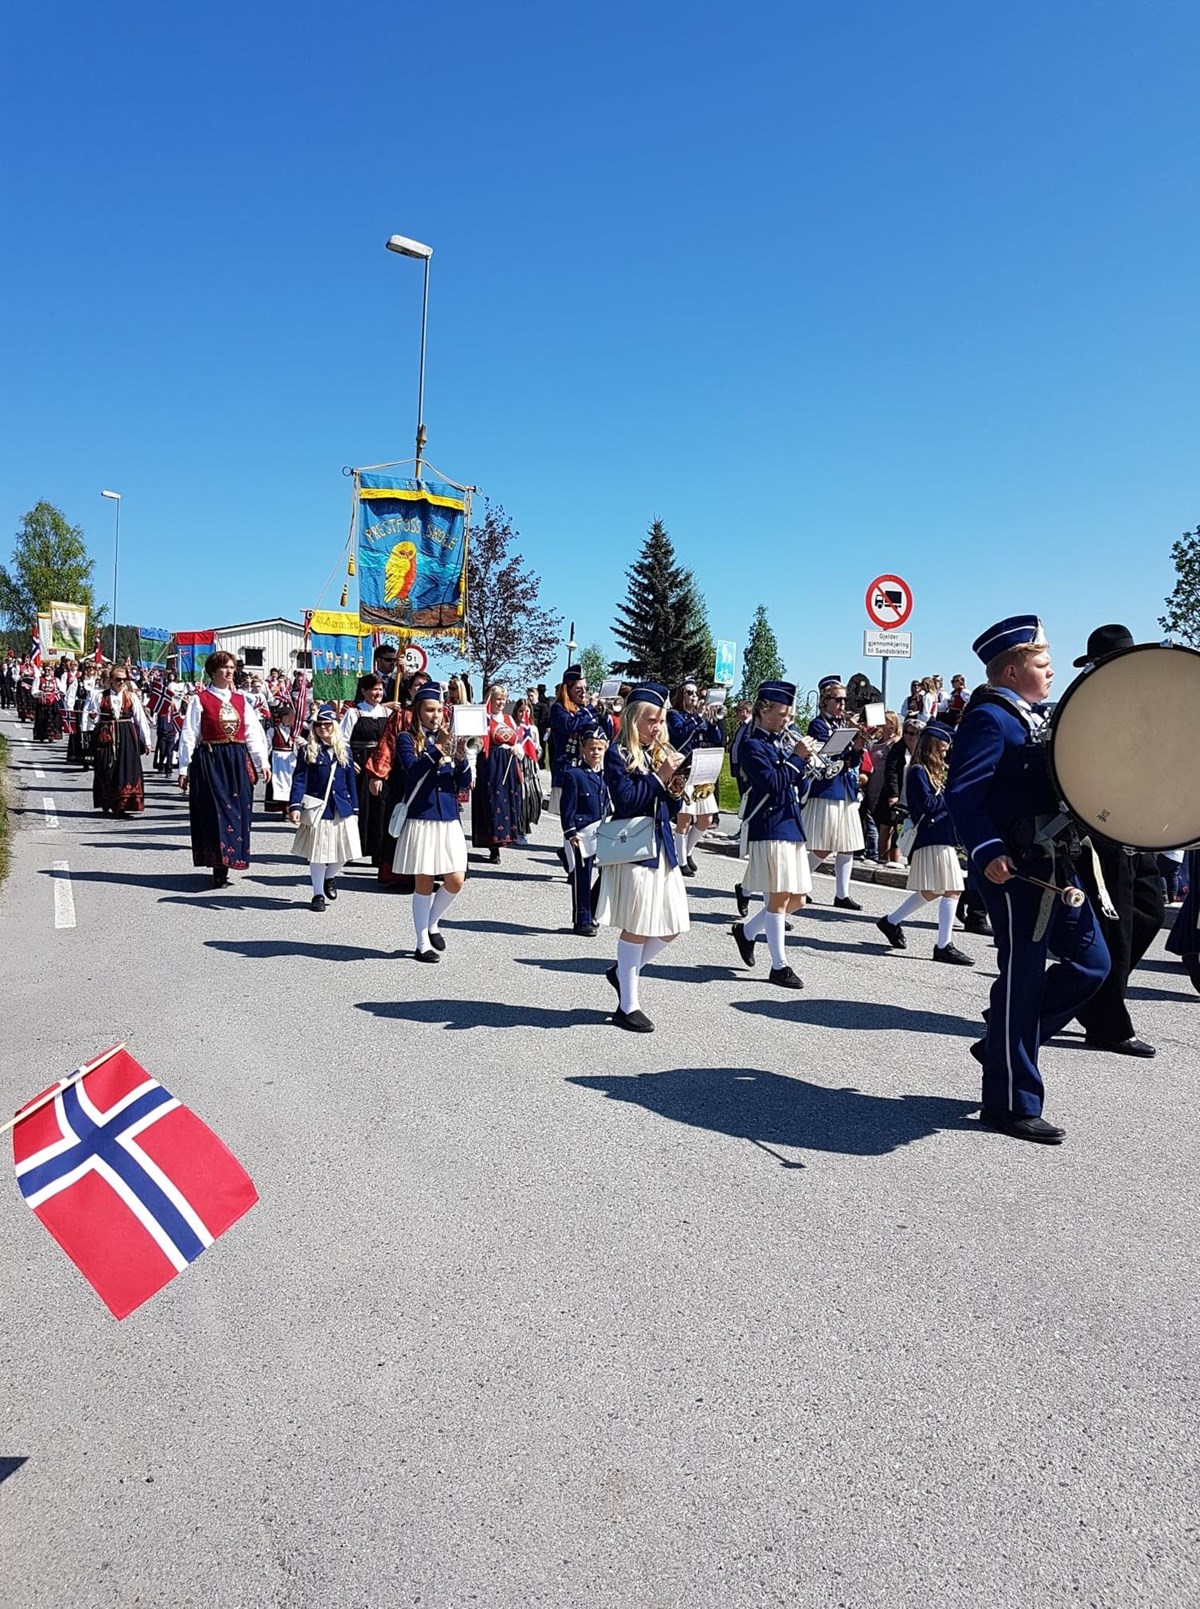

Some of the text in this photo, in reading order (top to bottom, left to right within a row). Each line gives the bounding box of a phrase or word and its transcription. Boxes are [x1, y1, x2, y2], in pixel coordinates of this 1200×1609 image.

[364, 516, 459, 551] PRESTFOSS SKOLE
[868, 641, 909, 649] gjennomkjøring
[406, 652, 412, 662] 6
